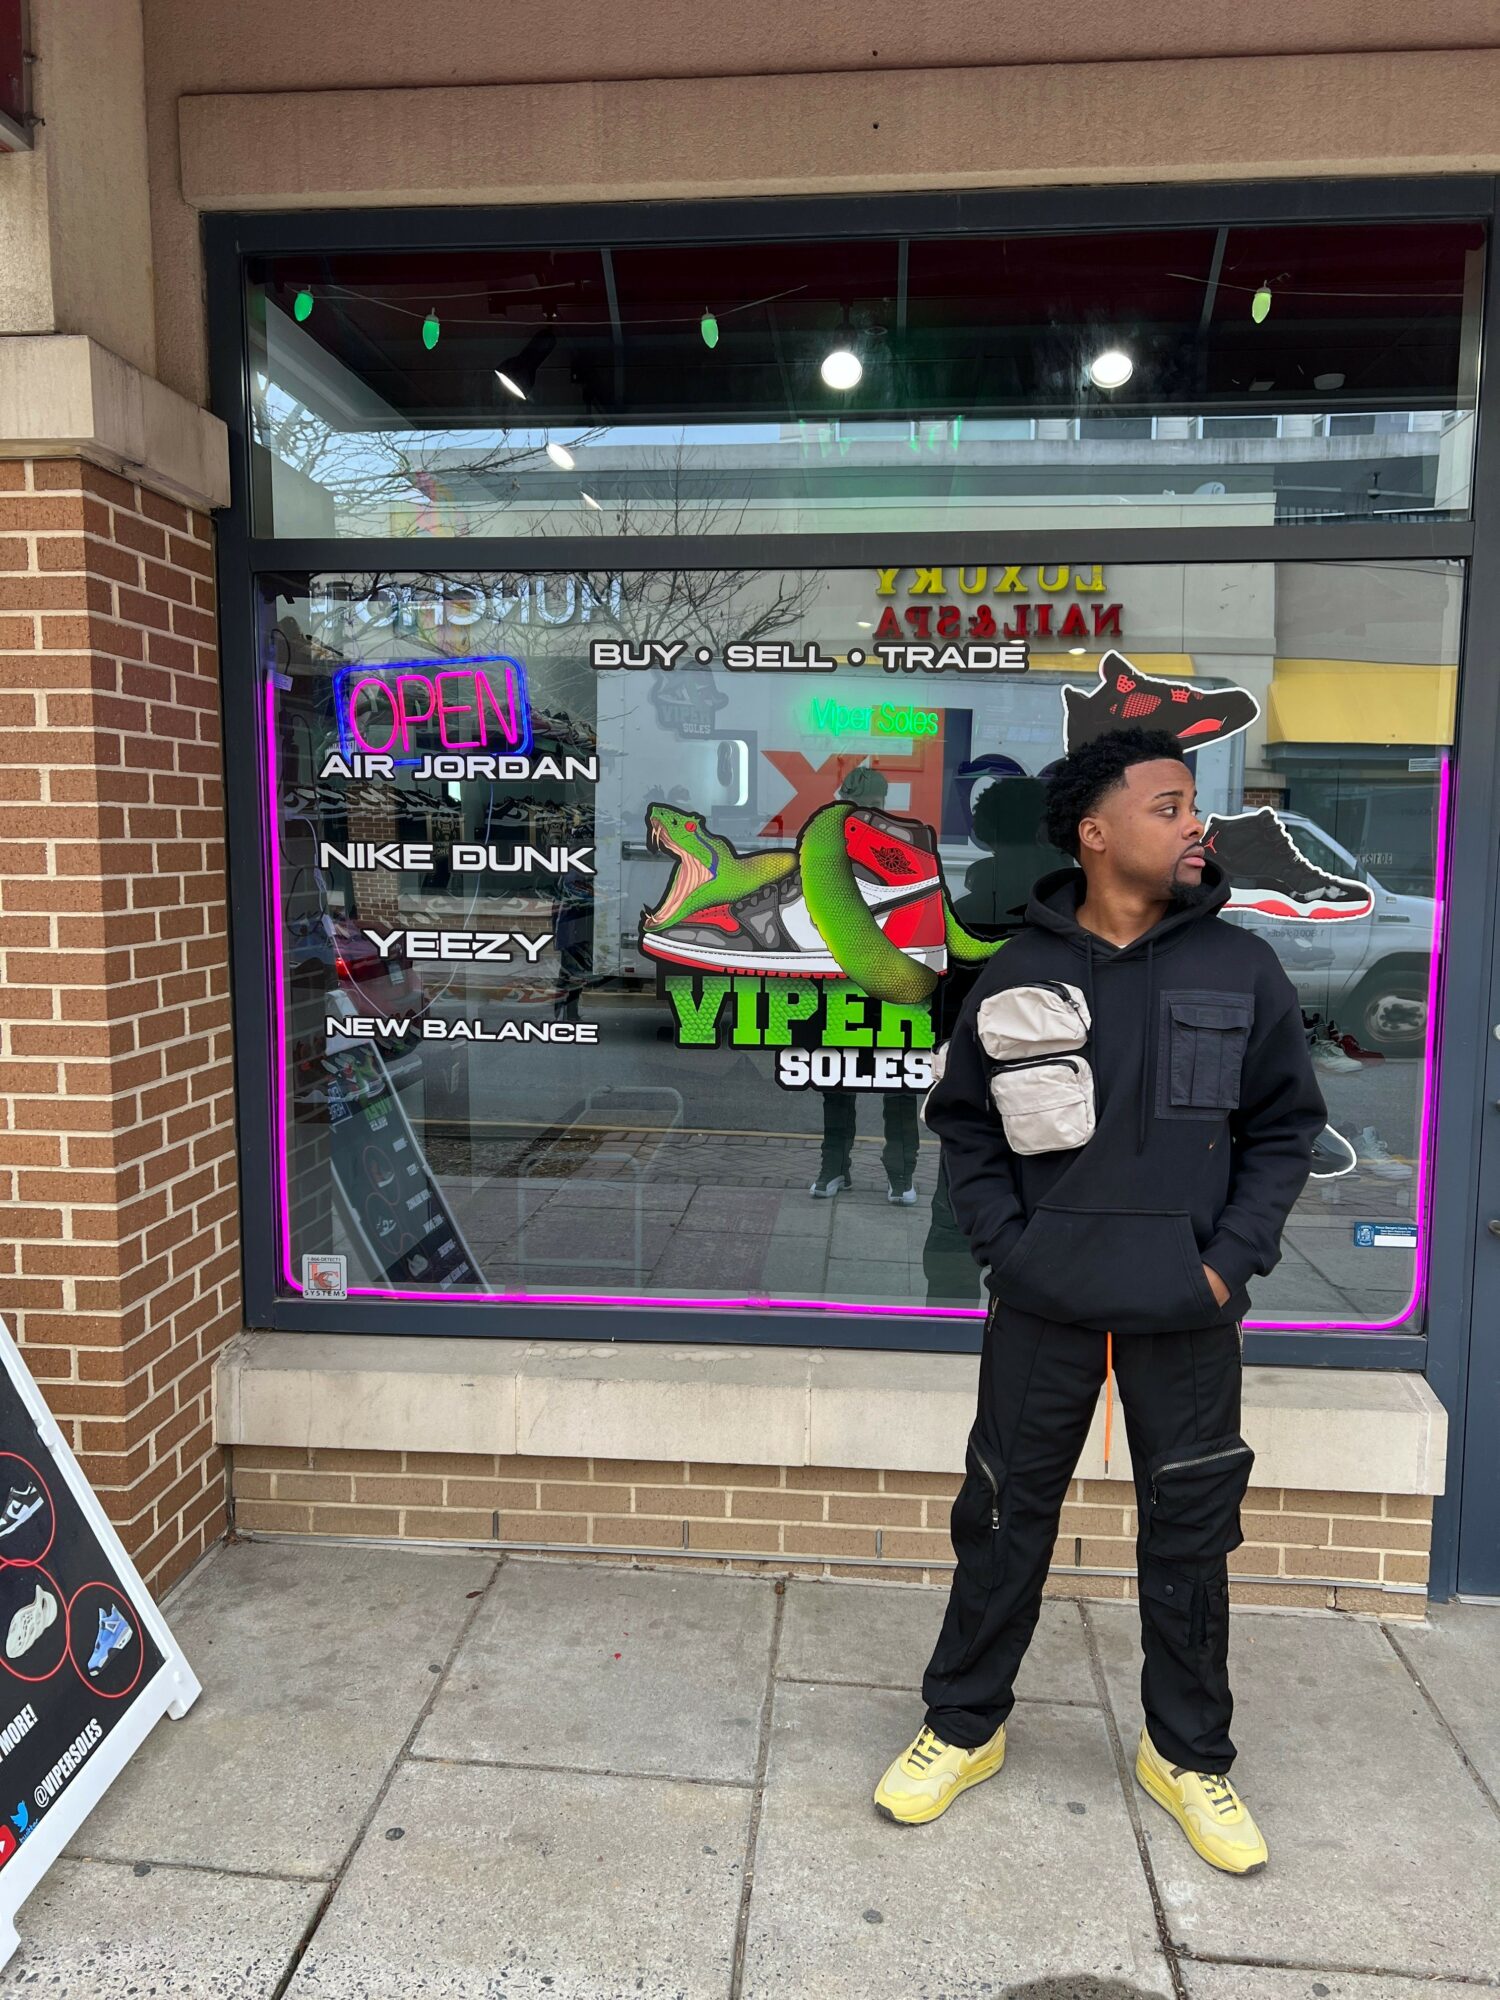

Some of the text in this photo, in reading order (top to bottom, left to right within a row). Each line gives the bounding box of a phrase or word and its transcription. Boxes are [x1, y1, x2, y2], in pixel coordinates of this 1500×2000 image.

[594, 644, 1026, 669] BUY SELL TRADE
[350, 667, 518, 755] OPEN
[811, 696, 938, 737] Viper Soles
[319, 755, 597, 780] AIR JORDAN
[320, 842, 434, 870] NIKE
[452, 845, 595, 873] DUNK
[363, 930, 554, 961] YEEZY
[327, 1017, 598, 1043] NEW BALANCE
[665, 976, 936, 1048] VIPER
[779, 1049, 936, 1089] SOLES
[0, 1703, 39, 1756] MORE!
[34, 1718, 103, 1808] @VIPERSOLES
